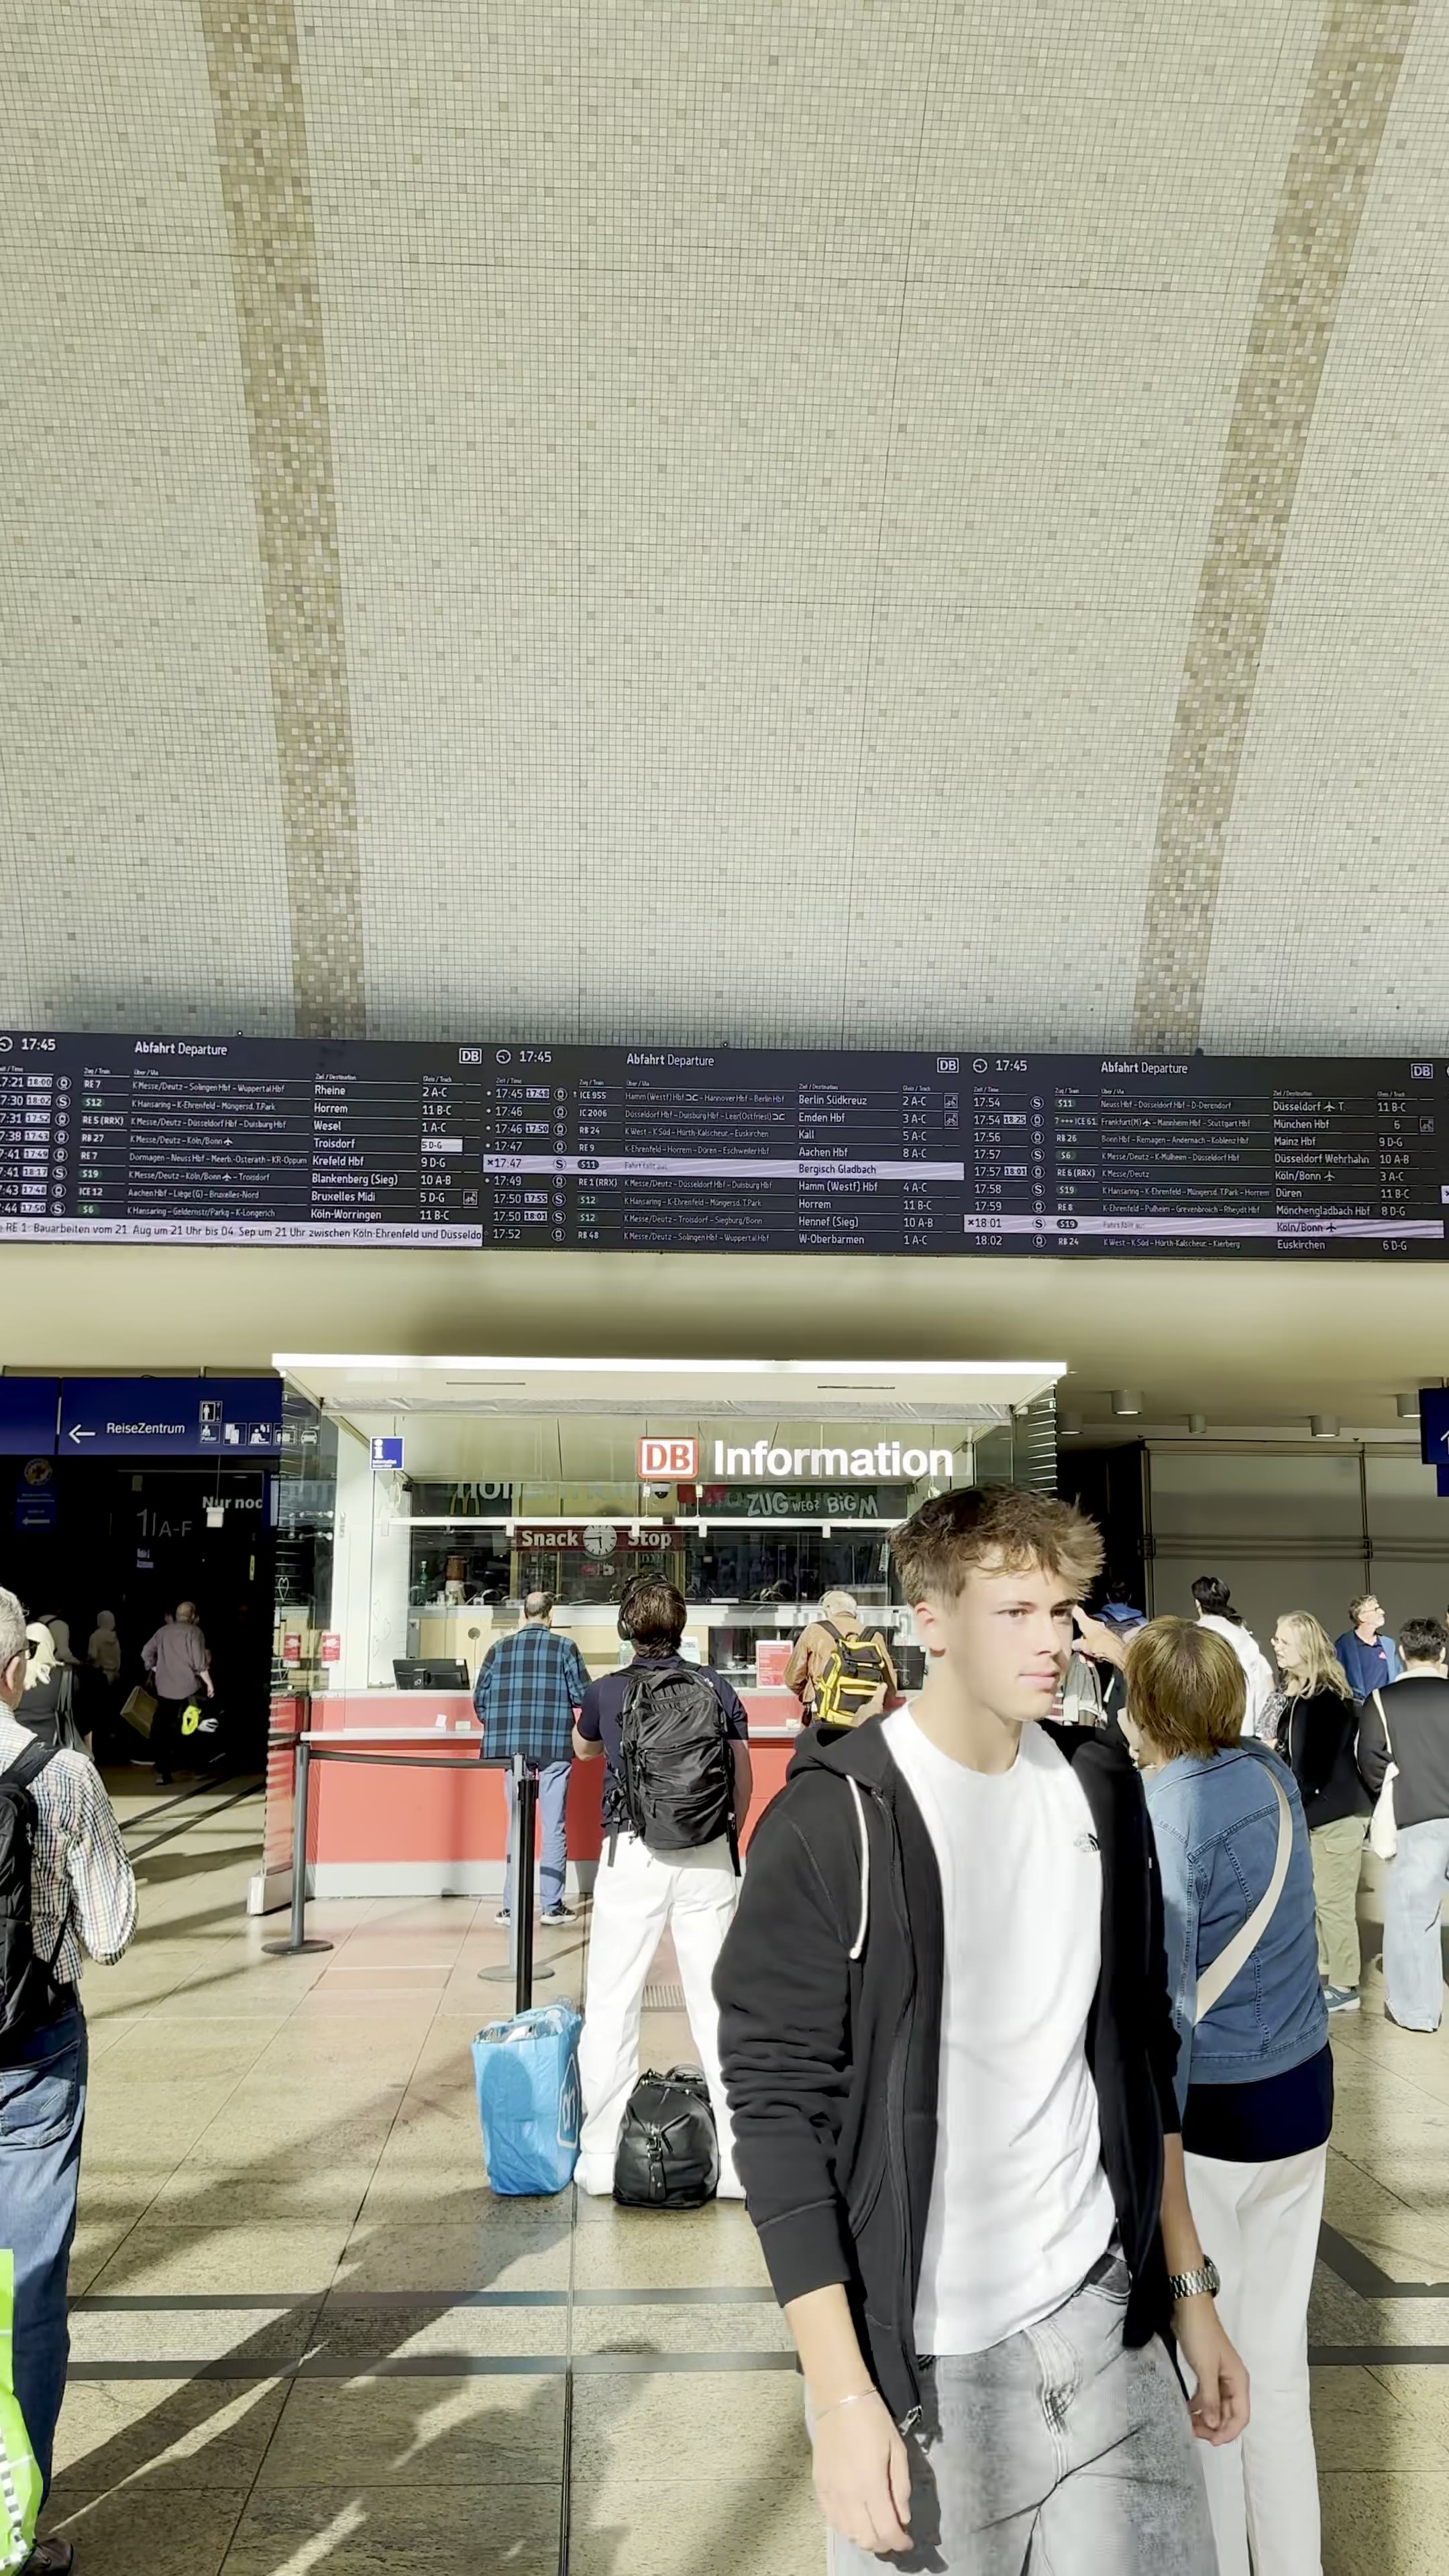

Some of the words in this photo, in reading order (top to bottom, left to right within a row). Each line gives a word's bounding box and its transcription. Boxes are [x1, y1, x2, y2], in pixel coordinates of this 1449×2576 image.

[21, 1038, 56, 1051] 17:45
[135, 1041, 175, 1055] Abfahrt
[178, 1042, 228, 1057] Departure
[461, 1049, 481, 1063] DB
[519, 1051, 552, 1063] 17:45
[627, 1053, 665, 1065] Abfahrt
[667, 1054, 714, 1068] Departure
[938, 1059, 958, 1071] DB
[996, 1060, 1028, 1071] 17:45
[1101, 1061, 1139, 1073] Abfahrt
[1141, 1062, 1188, 1075] Departure
[1412, 1065, 1432, 1077] DB
[0, 1077, 23, 1087] 7:21
[315, 1085, 346, 1095] Rheine
[423, 1087, 429, 1097] 2
[431, 1087, 447, 1097] A-C
[495, 1088, 523, 1099] 17:45
[592, 1091, 607, 1099] 955
[0, 1095, 23, 1106] 7:30
[799, 1095, 824, 1105] Berlin
[826, 1095, 867, 1106] Südkreuz
[902, 1097, 909, 1106] 2
[911, 1096, 927, 1106] A-C
[973, 1097, 1000, 1107] 17:54
[314, 1103, 347, 1114] Horrem
[1273, 1101, 1322, 1111] Düsseldorf
[1378, 1102, 1389, 1112] 11
[1392, 1102, 1406, 1112] B-C
[495, 1107, 523, 1117] 17:46
[0, 1113, 21, 1124] 7:31
[101, 1116, 124, 1126] (RRX)
[799, 1112, 828, 1122] Emden
[830, 1113, 845, 1123] Hbf
[973, 1115, 1000, 1124] 17:54
[313, 1121, 341, 1131] Wesel
[495, 1124, 523, 1134] 17:46
[1274, 1119, 1312, 1129] München
[1314, 1120, 1330, 1129] Hbf
[799, 1130, 814, 1140] Kall
[974, 1132, 1001, 1142] 17:56
[314, 1138, 355, 1148] Troisdorf
[1275, 1136, 1299, 1146] Mainz
[1301, 1136, 1316, 1146] Hbf
[494, 1141, 522, 1152] 17:47
[799, 1147, 831, 1157] Aachen
[833, 1147, 848, 1157] Hbf
[974, 1149, 1001, 1159] 17:57
[313, 1156, 346, 1166] Krefeld
[348, 1157, 364, 1167] Hbf
[494, 1159, 522, 1168] 17:47
[1275, 1153, 1323, 1163] Düsseldorf
[1326, 1154, 1370, 1165] Wehrhahn
[1379, 1155, 1391, 1164] 10
[1394, 1155, 1409, 1165] A-B
[581, 1161, 596, 1169] S11
[799, 1164, 835, 1176] Bergisch
[838, 1165, 877, 1174] Gladbach
[82, 1169, 99, 1178] S19
[974, 1167, 1001, 1177] 17:57
[1275, 1171, 1322, 1181] Köln/Bonn
[312, 1174, 369, 1187] Blankenberg
[371, 1174, 398, 1186] (Sieg)
[494, 1176, 522, 1186] 17:49
[79, 1188, 91, 1196] ICE
[93, 1188, 103, 1196] 12
[799, 1181, 825, 1191] Hamm
[827, 1181, 861, 1193] (Westf)
[863, 1182, 878, 1192] Hbf
[975, 1184, 1002, 1193] 17:58
[311, 1191, 356, 1201] Bruxelles
[358, 1192, 376, 1201] Midi
[1276, 1188, 1302, 1197] Düren
[494, 1194, 521, 1204] 17:50
[580, 1196, 596, 1204] S12
[83, 1205, 94, 1214] S6
[799, 1199, 831, 1210] Horrem
[904, 1200, 915, 1210] 11
[918, 1200, 932, 1210] B-C
[975, 1201, 1002, 1211] 17:59
[311, 1210, 382, 1222] Köln-Worringen
[1277, 1205, 1353, 1218] Mönchengladbach
[1355, 1206, 1371, 1216] Hbf
[493, 1212, 521, 1222] 17:50
[799, 1216, 830, 1226] Hennef
[833, 1216, 859, 1228] (Sieg)
[904, 1218, 915, 1228] 10
[918, 1218, 933, 1228] A-B
[975, 1218, 1002, 1228] 18:01
[6, 1222, 17, 1232] RE
[34, 1223, 90, 1234] Bauarbeiten
[93, 1226, 113, 1234] vom
[133, 1226, 152, 1237] Aug
[170, 1226, 183, 1235] 21
[186, 1226, 201, 1235] Uhr
[205, 1226, 218, 1236] bis
[239, 1227, 256, 1238] Sep
[275, 1228, 286, 1236] 21
[290, 1228, 305, 1237] Uhr
[309, 1229, 350, 1238] zwischen
[353, 1228, 419, 1239] Köln-Ehrenfeld
[422, 1230, 438, 1239] und
[493, 1229, 521, 1239] 17:52
[799, 1234, 865, 1244] W-Oberbarmen
[975, 1236, 1002, 1245] 18:02
[1277, 1240, 1326, 1250] Euskirchen
[107, 1422, 186, 1434] ReiseZentrum
[643, 1442, 692, 1473] DB
[714, 1440, 953, 1477] Information
[203, 1496, 232, 1509] Nur
[746, 1491, 789, 1517] ZUG
[859, 1494, 879, 1519] M
[522, 1529, 579, 1547] Snack
[628, 1532, 672, 1549] Stop
